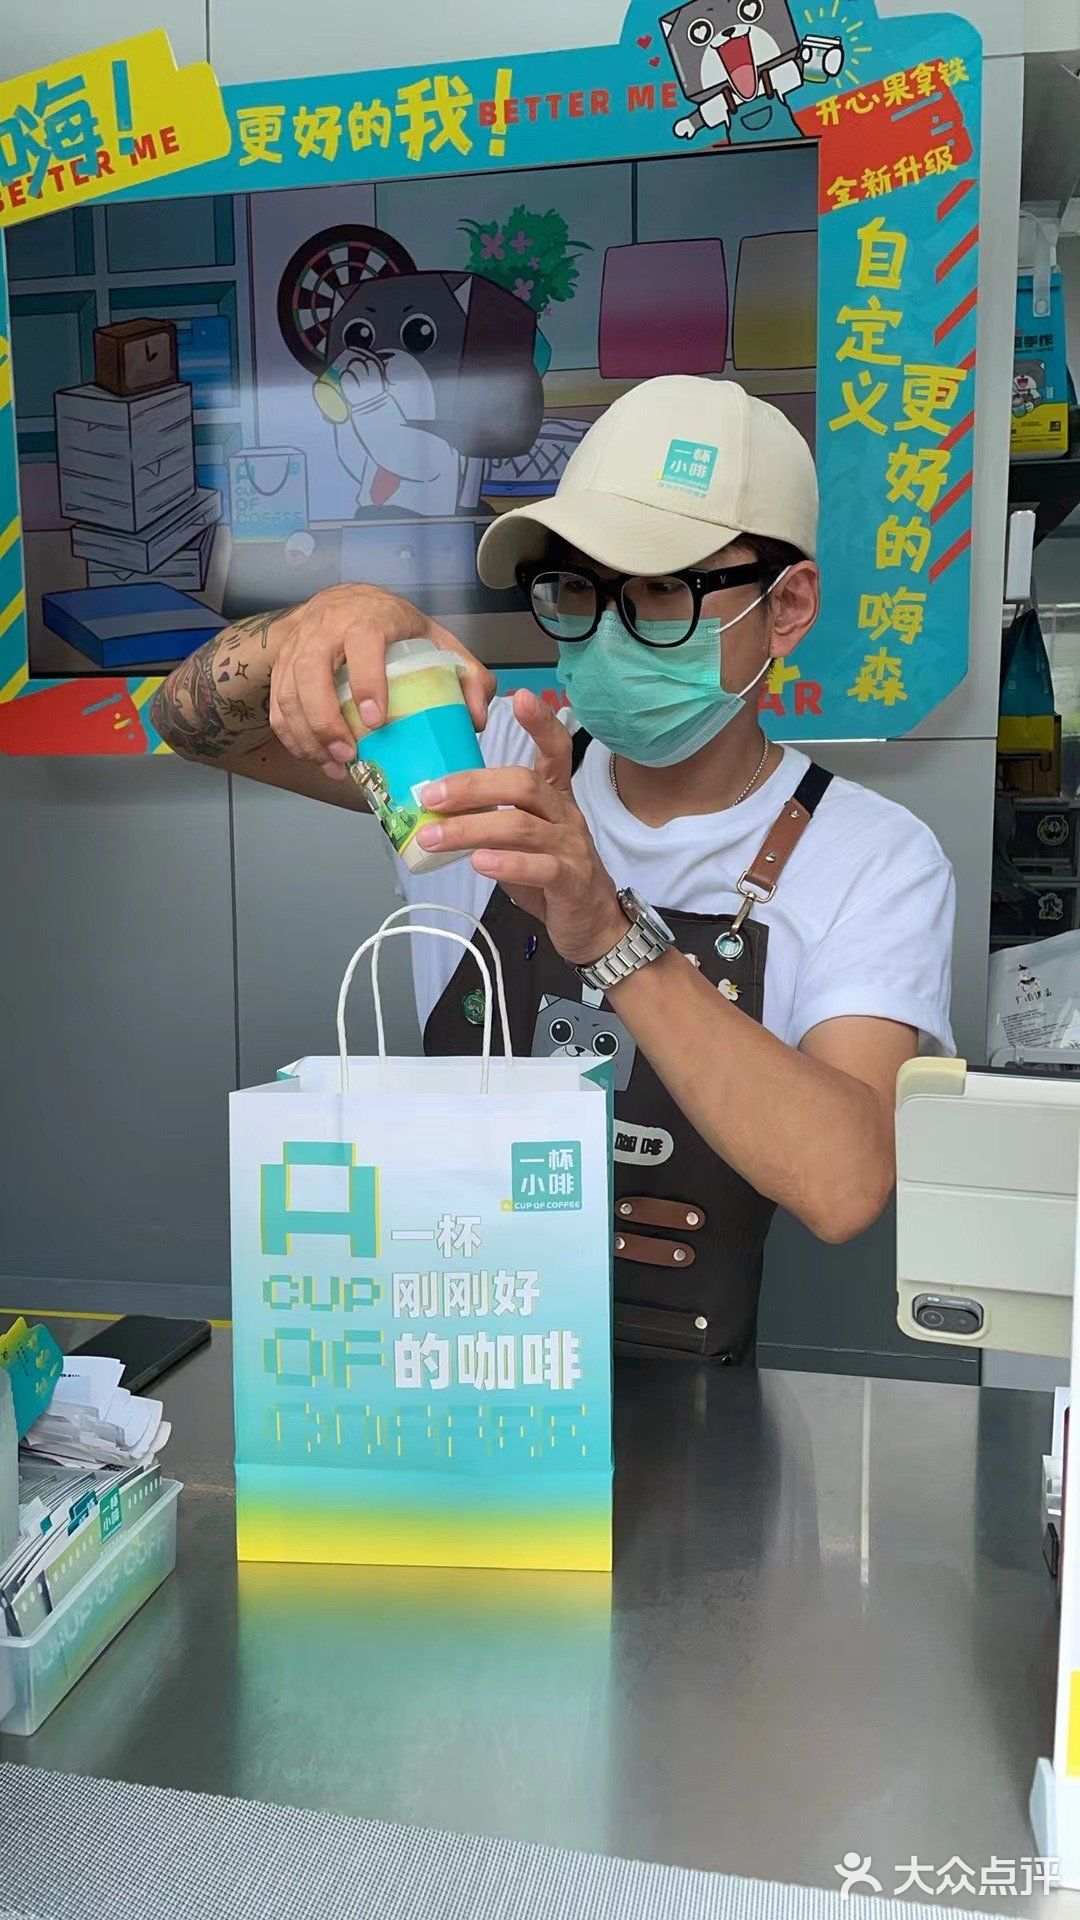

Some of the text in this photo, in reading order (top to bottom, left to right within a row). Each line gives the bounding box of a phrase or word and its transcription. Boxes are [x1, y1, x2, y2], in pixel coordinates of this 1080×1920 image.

[478, 81, 679, 127] BETTER ME
[816, 57, 970, 126] 开心果拿铁
[129, 125, 180, 167] ME
[826, 145, 958, 211] 全新升级
[829, 216, 907, 436] 自定义
[848, 364, 967, 707] 更好的嗨森
[519, 1148, 574, 1172] 一杯
[520, 1173, 575, 1196] 小啡
[260, 1141, 381, 1258] A
[515, 1202, 532, 1210] CUP
[547, 1200, 580, 1209] COFFEE
[391, 1214, 483, 1258] 一杯
[262, 1274, 382, 1312] CUP
[392, 1269, 541, 1318] 刚刚好
[263, 1327, 387, 1389] OF
[393, 1330, 583, 1391] 的咖啡
